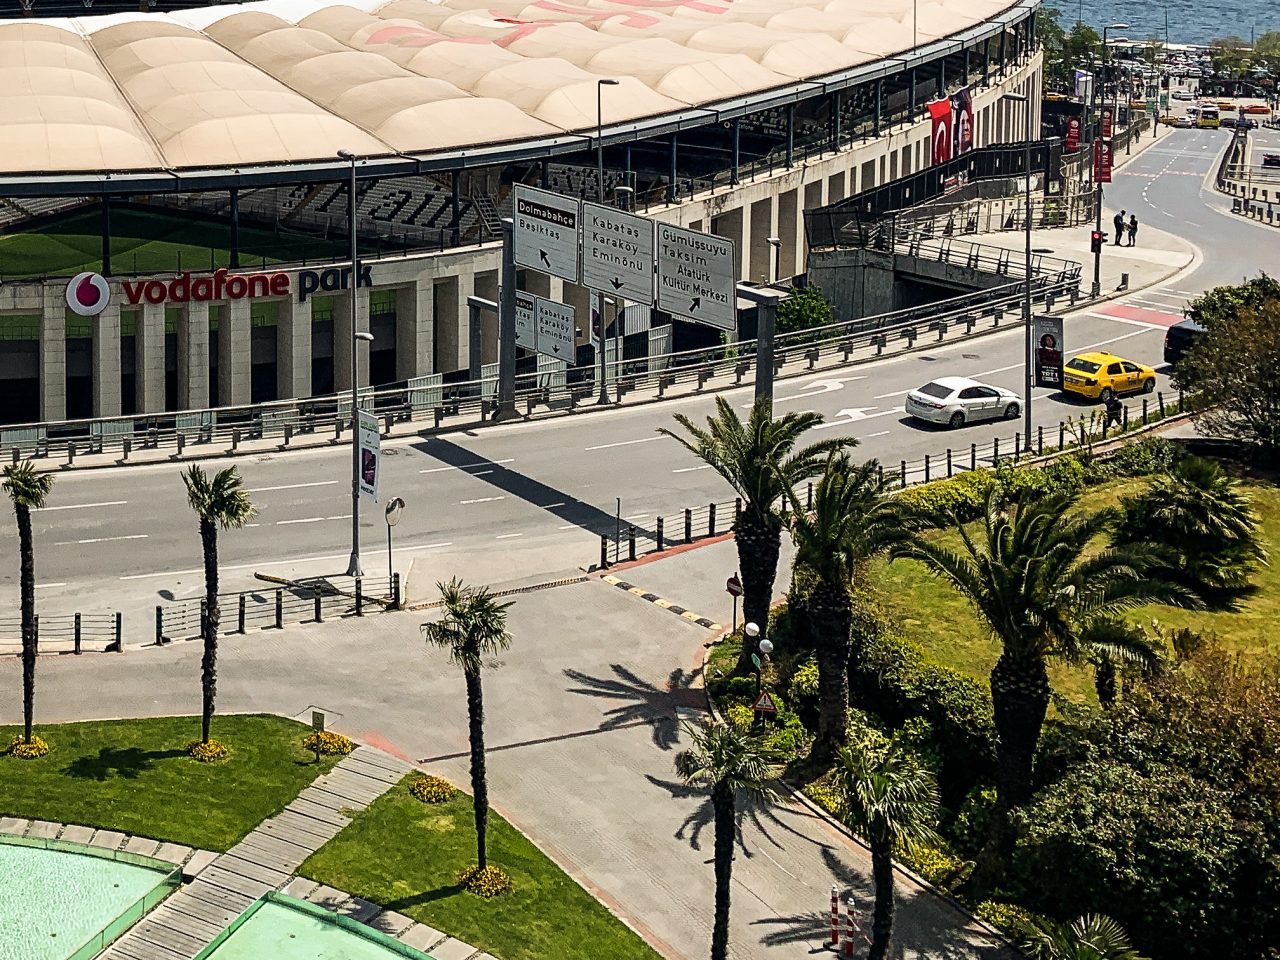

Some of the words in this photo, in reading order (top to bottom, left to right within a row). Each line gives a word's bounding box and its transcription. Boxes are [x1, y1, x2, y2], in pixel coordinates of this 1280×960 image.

[519, 202, 574, 226] Dolmabahçe
[519, 219, 560, 241] Beşiktaş
[593, 216, 639, 239] Kabataş
[593, 231, 639, 256] Karaköy
[662, 229, 727, 257] Gümüşsuyu
[593, 247, 643, 271] Eminönü
[663, 245, 707, 266] Taksim
[122, 268, 290, 304] vodafone
[299, 259, 373, 302] park
[677, 264, 711, 283] Atatürk
[662, 274, 690, 292] Kültür
[692, 283, 729, 304] Merkezi
